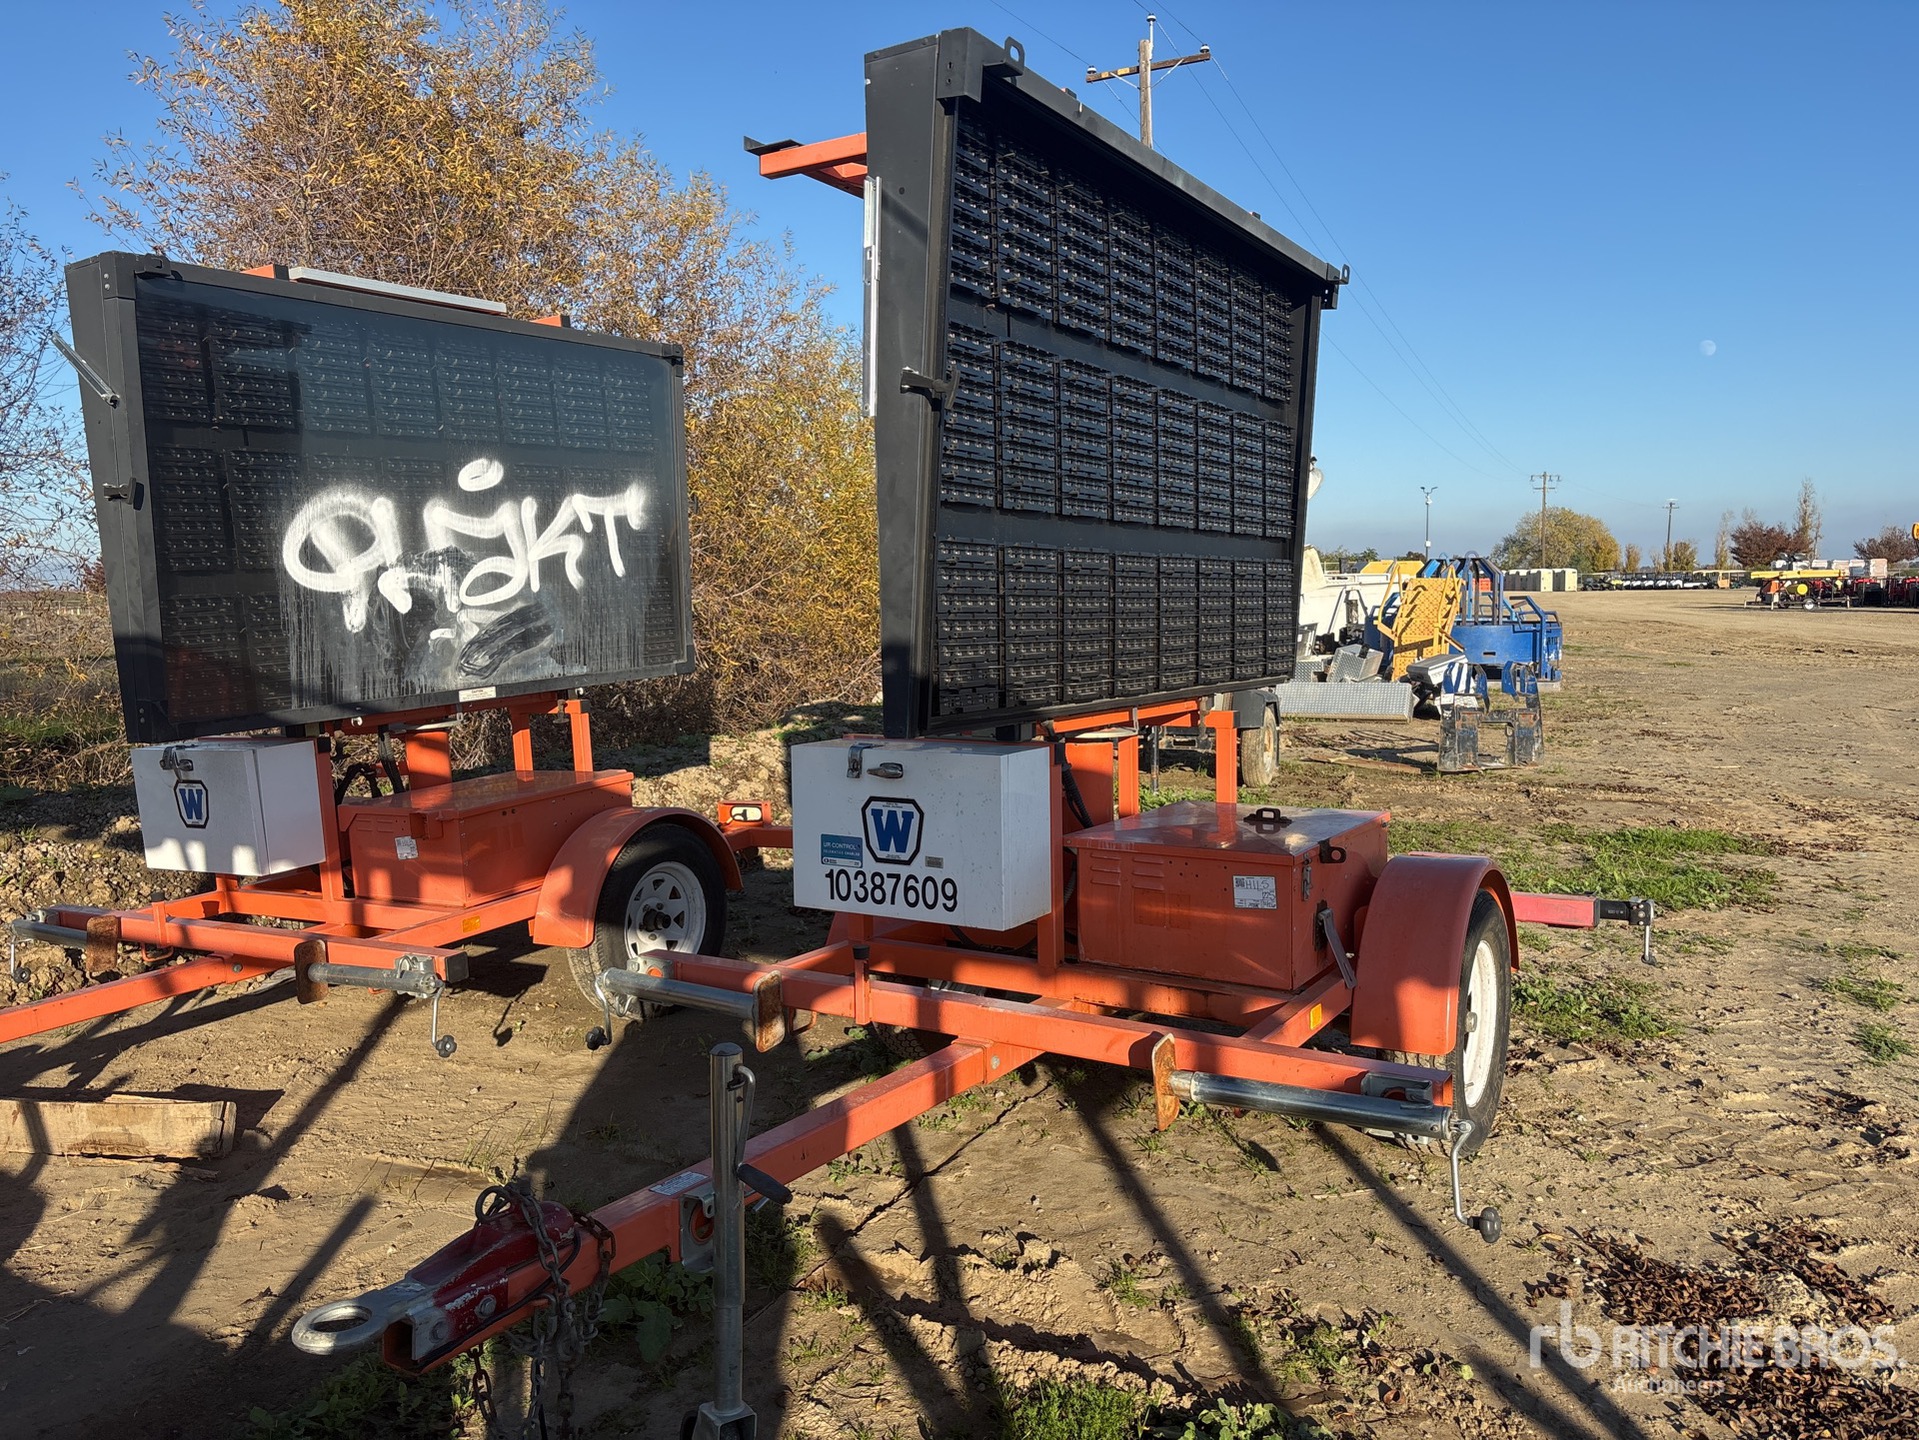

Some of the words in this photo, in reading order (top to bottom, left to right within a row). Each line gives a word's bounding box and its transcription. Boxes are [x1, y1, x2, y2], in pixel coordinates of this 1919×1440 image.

[179, 788, 203, 820] W
[831, 842, 857, 850] CONTROL
[871, 808, 914, 853] W
[825, 868, 957, 911] 10387609
